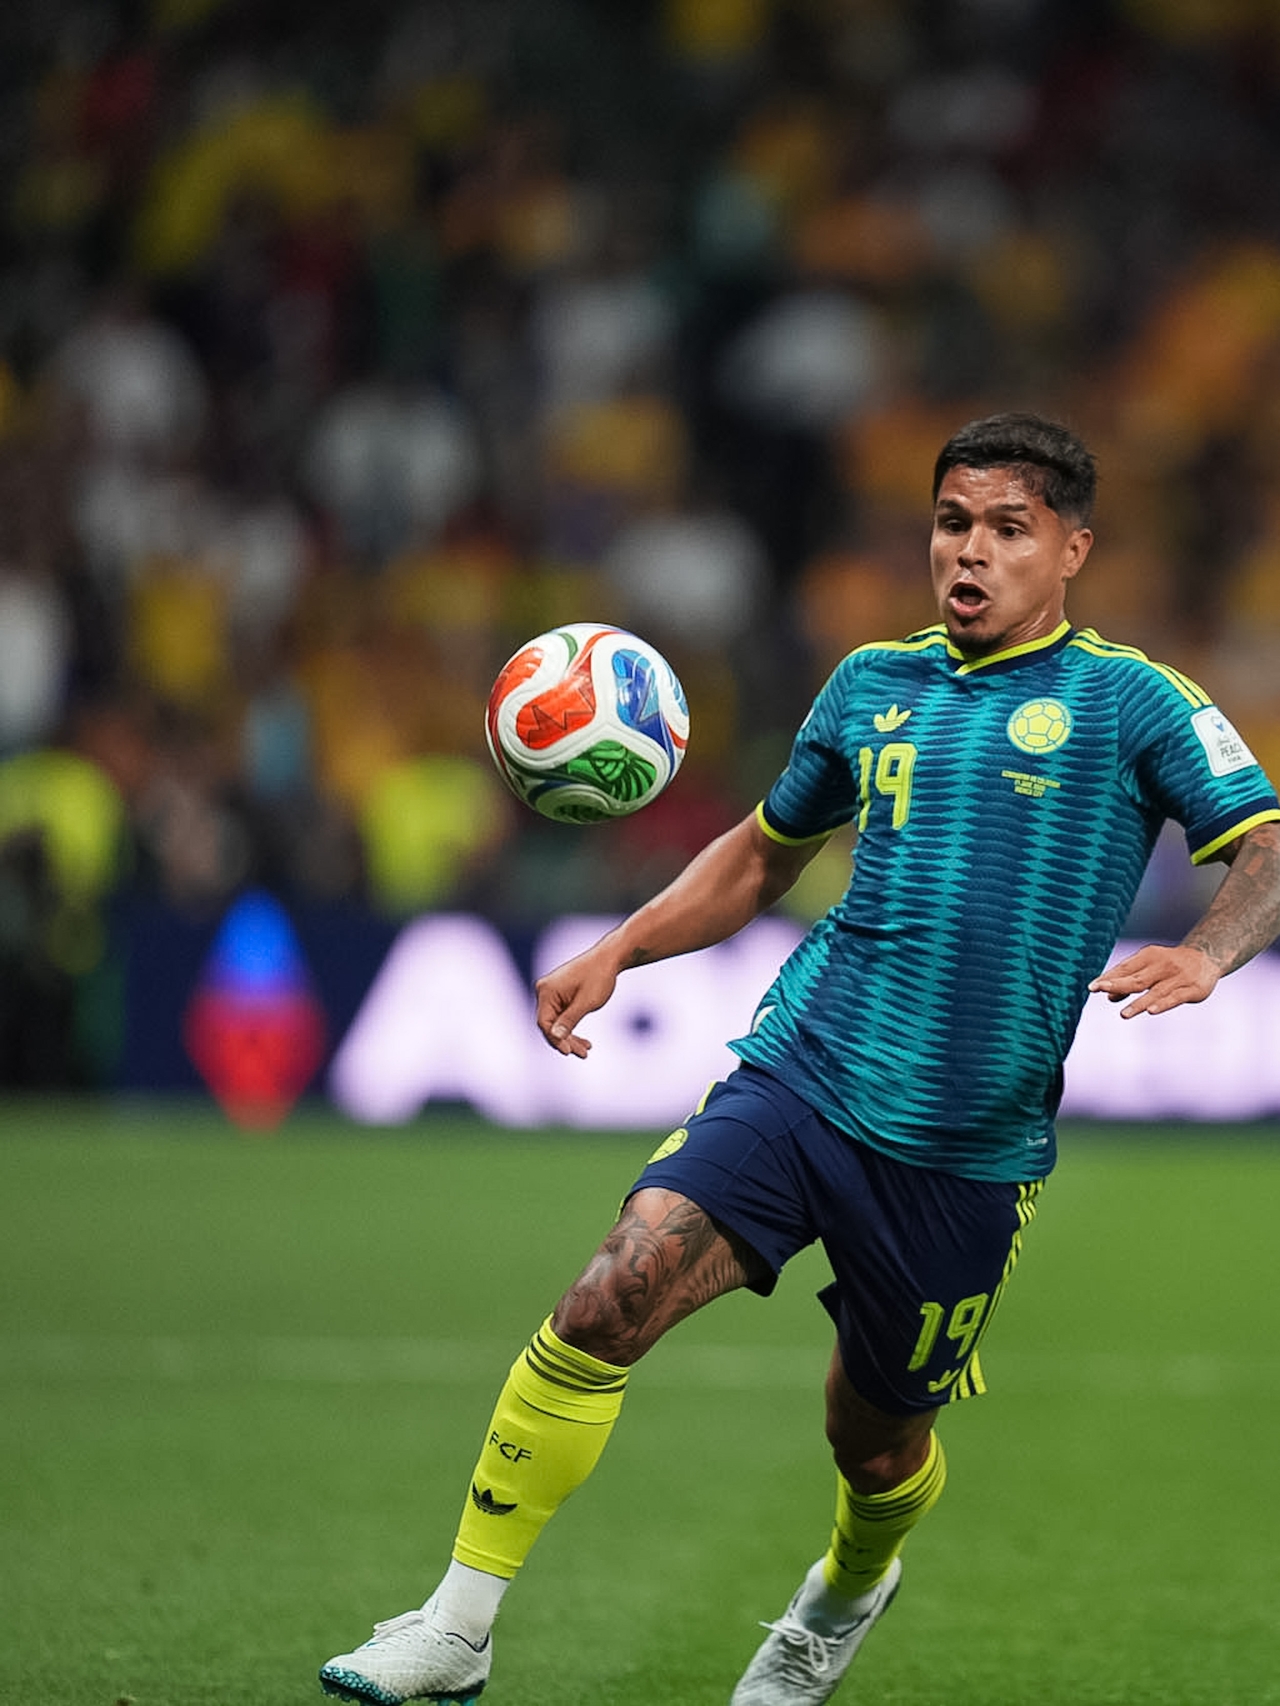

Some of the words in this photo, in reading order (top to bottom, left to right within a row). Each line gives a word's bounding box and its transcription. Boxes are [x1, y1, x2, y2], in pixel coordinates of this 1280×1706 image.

[858, 742, 918, 833] 19
[907, 1292, 989, 1372] 19
[488, 1430, 533, 1463] FCF
